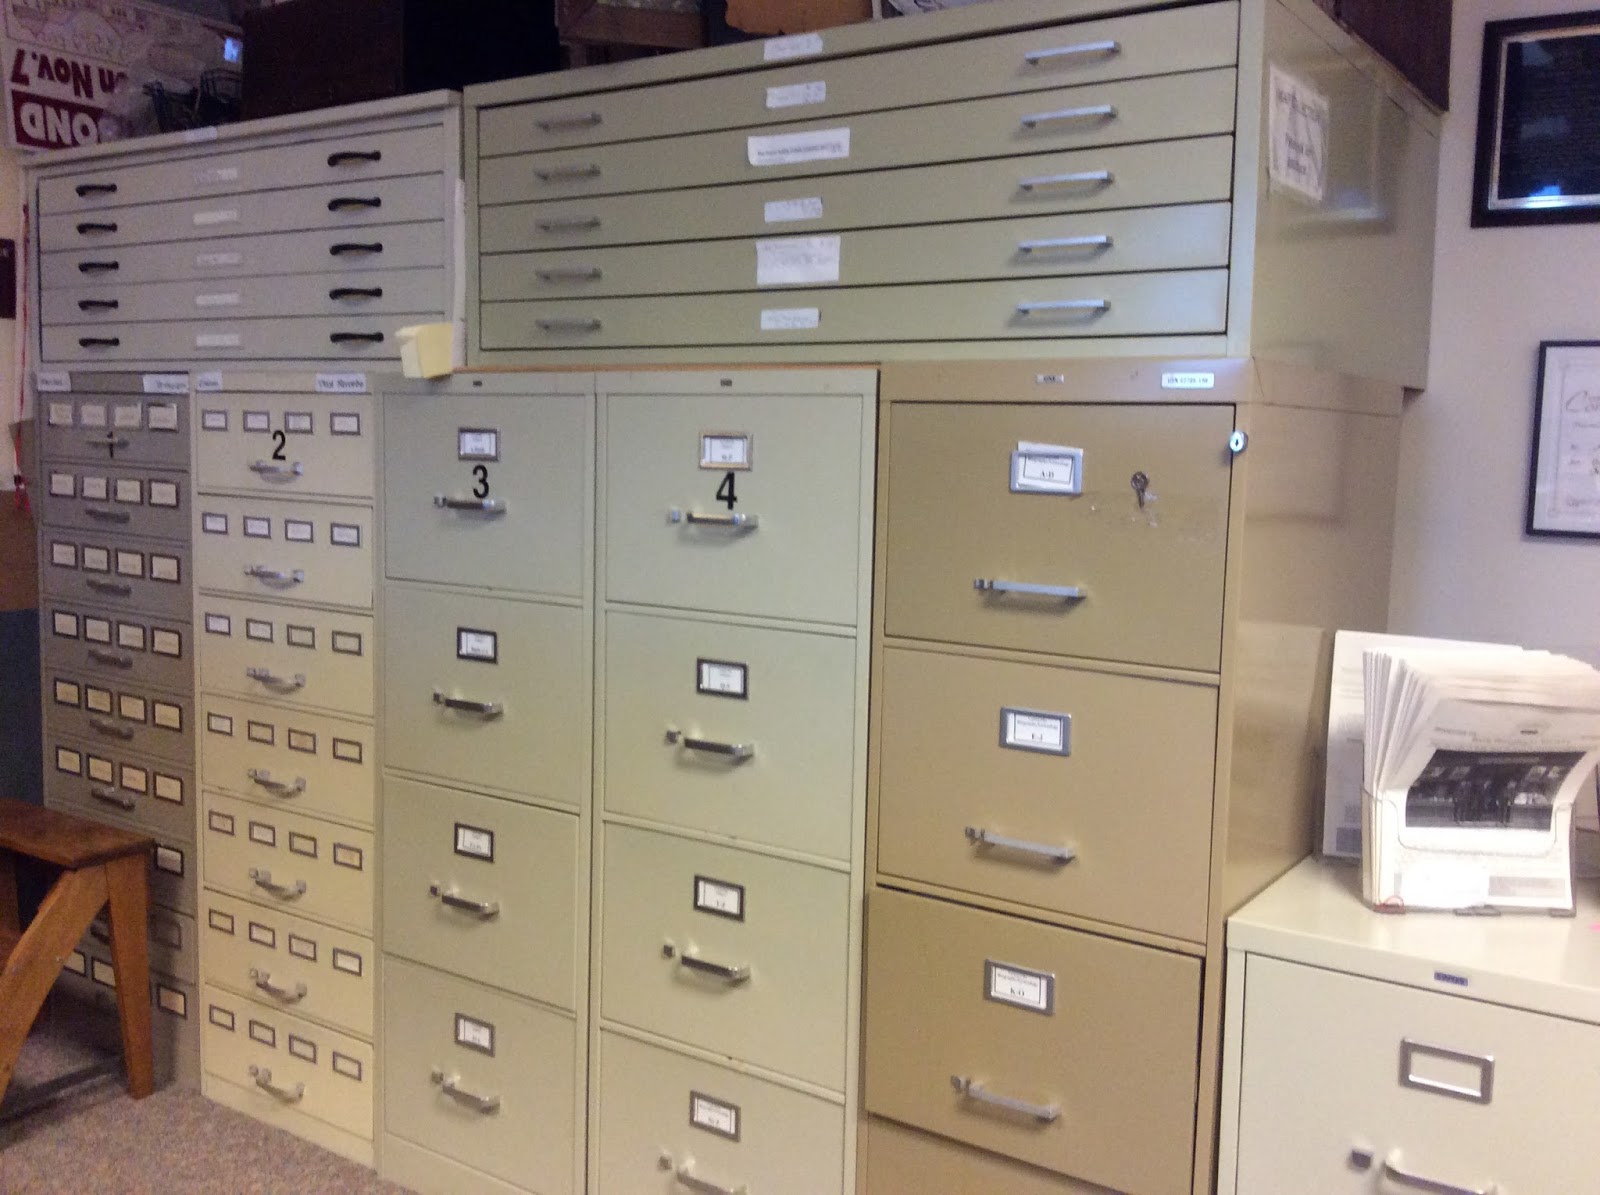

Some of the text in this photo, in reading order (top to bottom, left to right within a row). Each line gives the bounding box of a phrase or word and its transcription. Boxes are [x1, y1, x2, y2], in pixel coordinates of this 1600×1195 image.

[272, 430, 286, 461] 2
[473, 464, 490, 499] 3
[716, 471, 738, 510] 4
